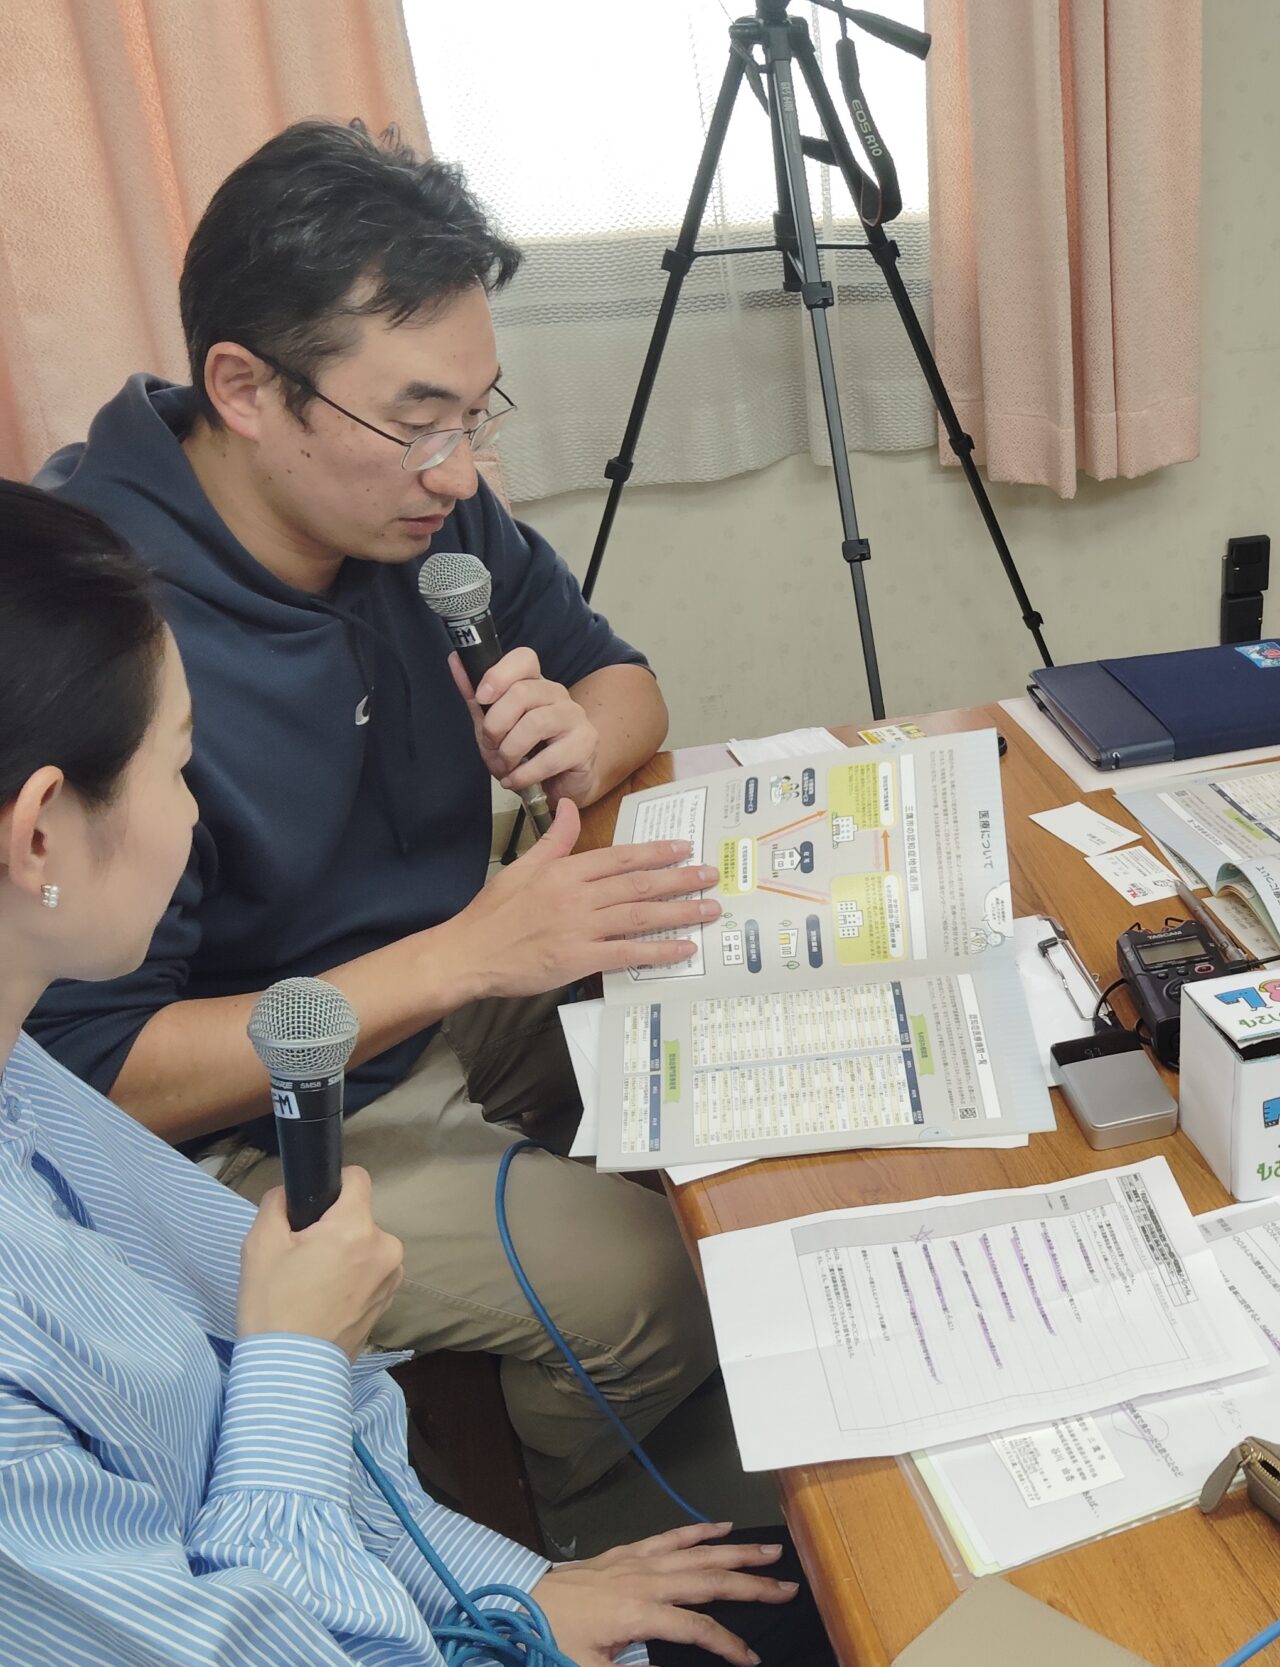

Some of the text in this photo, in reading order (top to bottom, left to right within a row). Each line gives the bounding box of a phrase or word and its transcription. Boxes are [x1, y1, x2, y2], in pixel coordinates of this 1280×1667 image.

[852, 99, 882, 157] EOS R10
[904, 806, 920, 892] 三鷹市の認知症地域連携
[977, 810, 994, 869] 医療について
[1147, 930, 1185, 941] TASCAM
[300, 1081, 322, 1089] SM58
